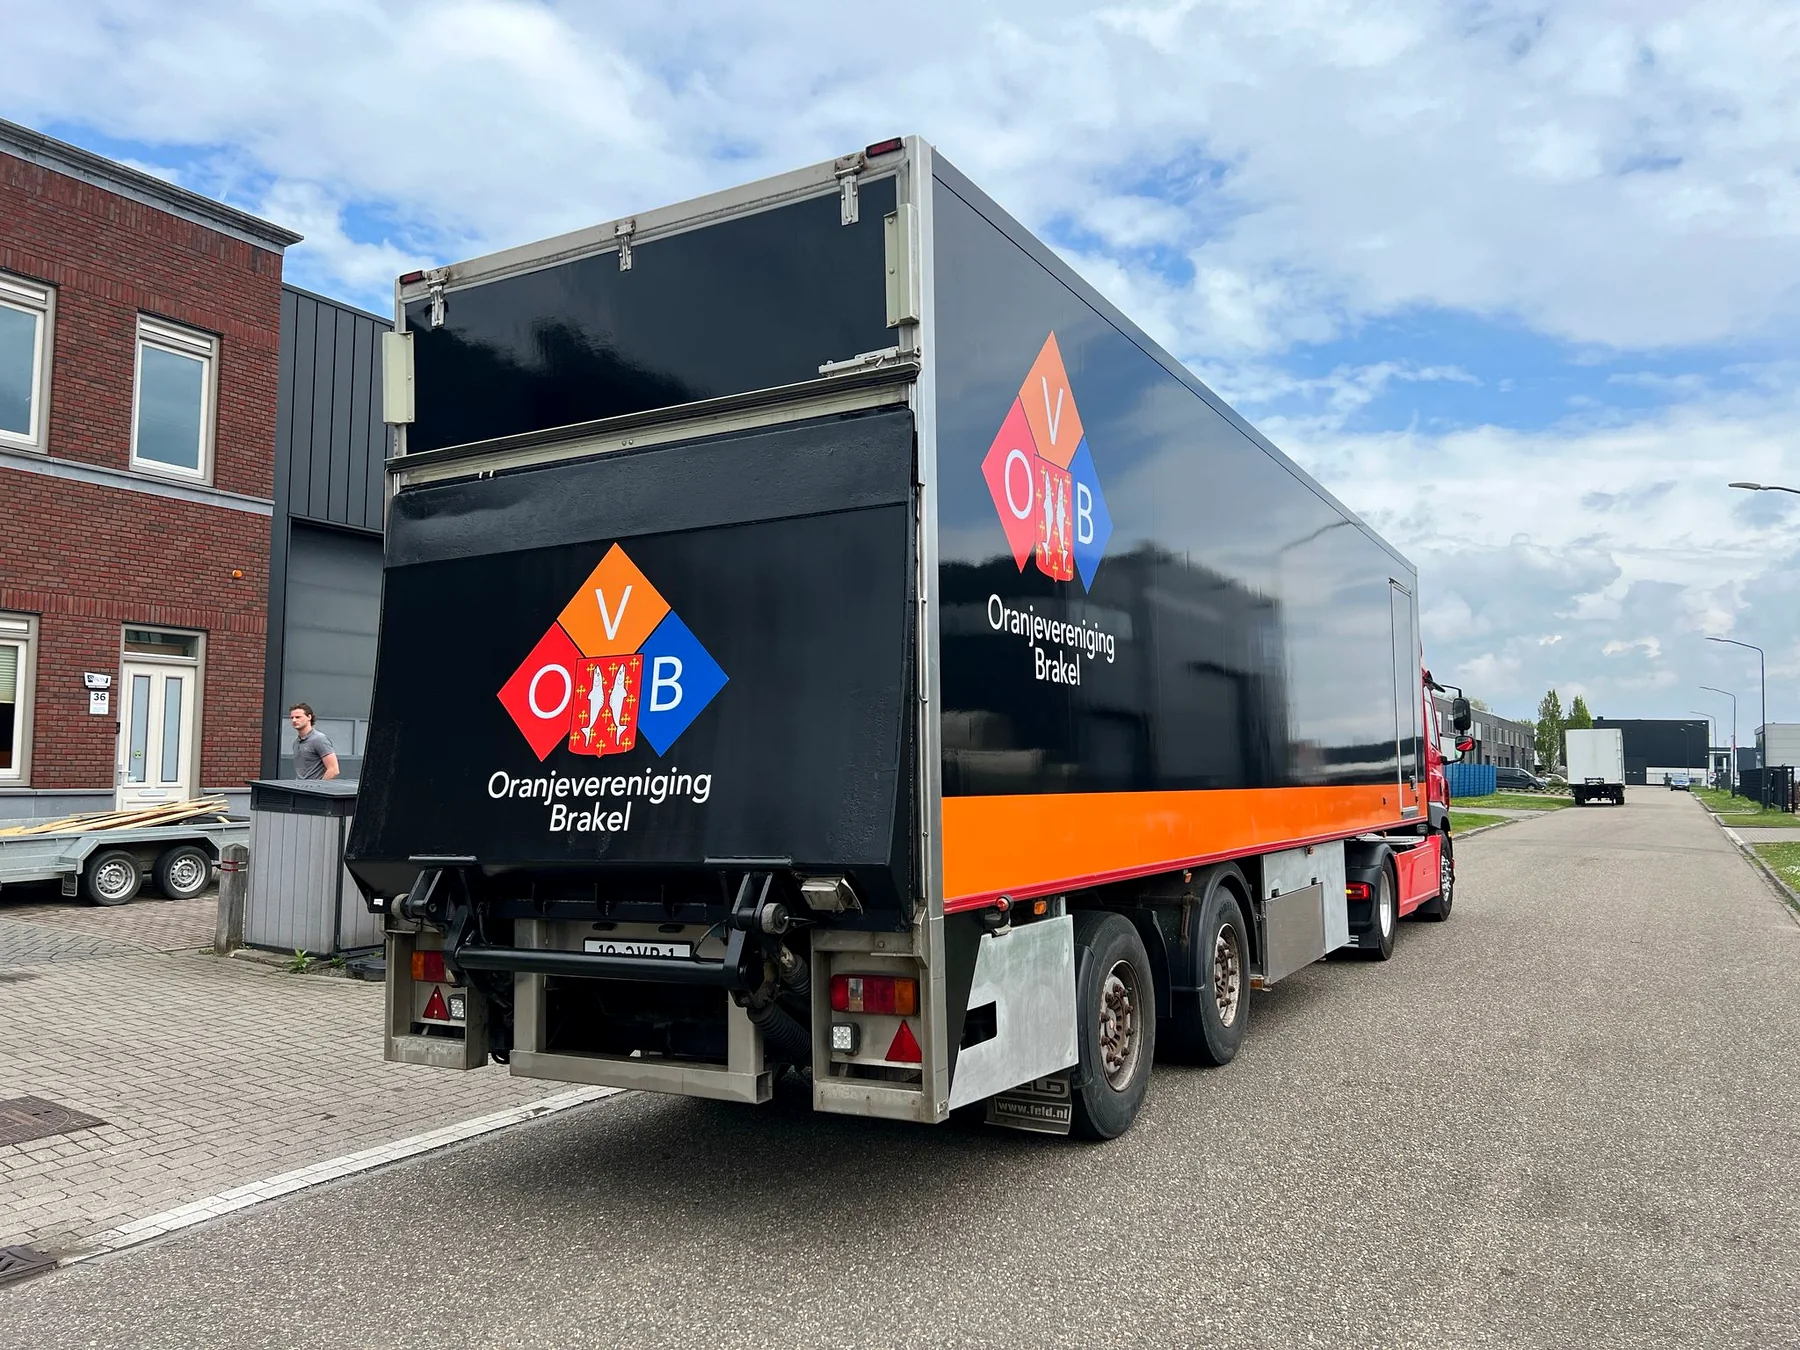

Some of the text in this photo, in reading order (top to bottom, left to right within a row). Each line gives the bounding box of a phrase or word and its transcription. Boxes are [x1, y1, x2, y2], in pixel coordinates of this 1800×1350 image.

[1041, 376, 1064, 446] V
[1004, 448, 1094, 545] O B
[594, 585, 633, 640] V
[987, 593, 1115, 664] Oranjevereniging
[528, 656, 683, 719] O B
[1034, 646, 1081, 686] Brakel
[93, 692, 106, 701] 36
[488, 767, 712, 806] Oranjevereniging
[549, 801, 632, 832] Brakel
[998, 1102, 1068, 1120] www.feld.nl
